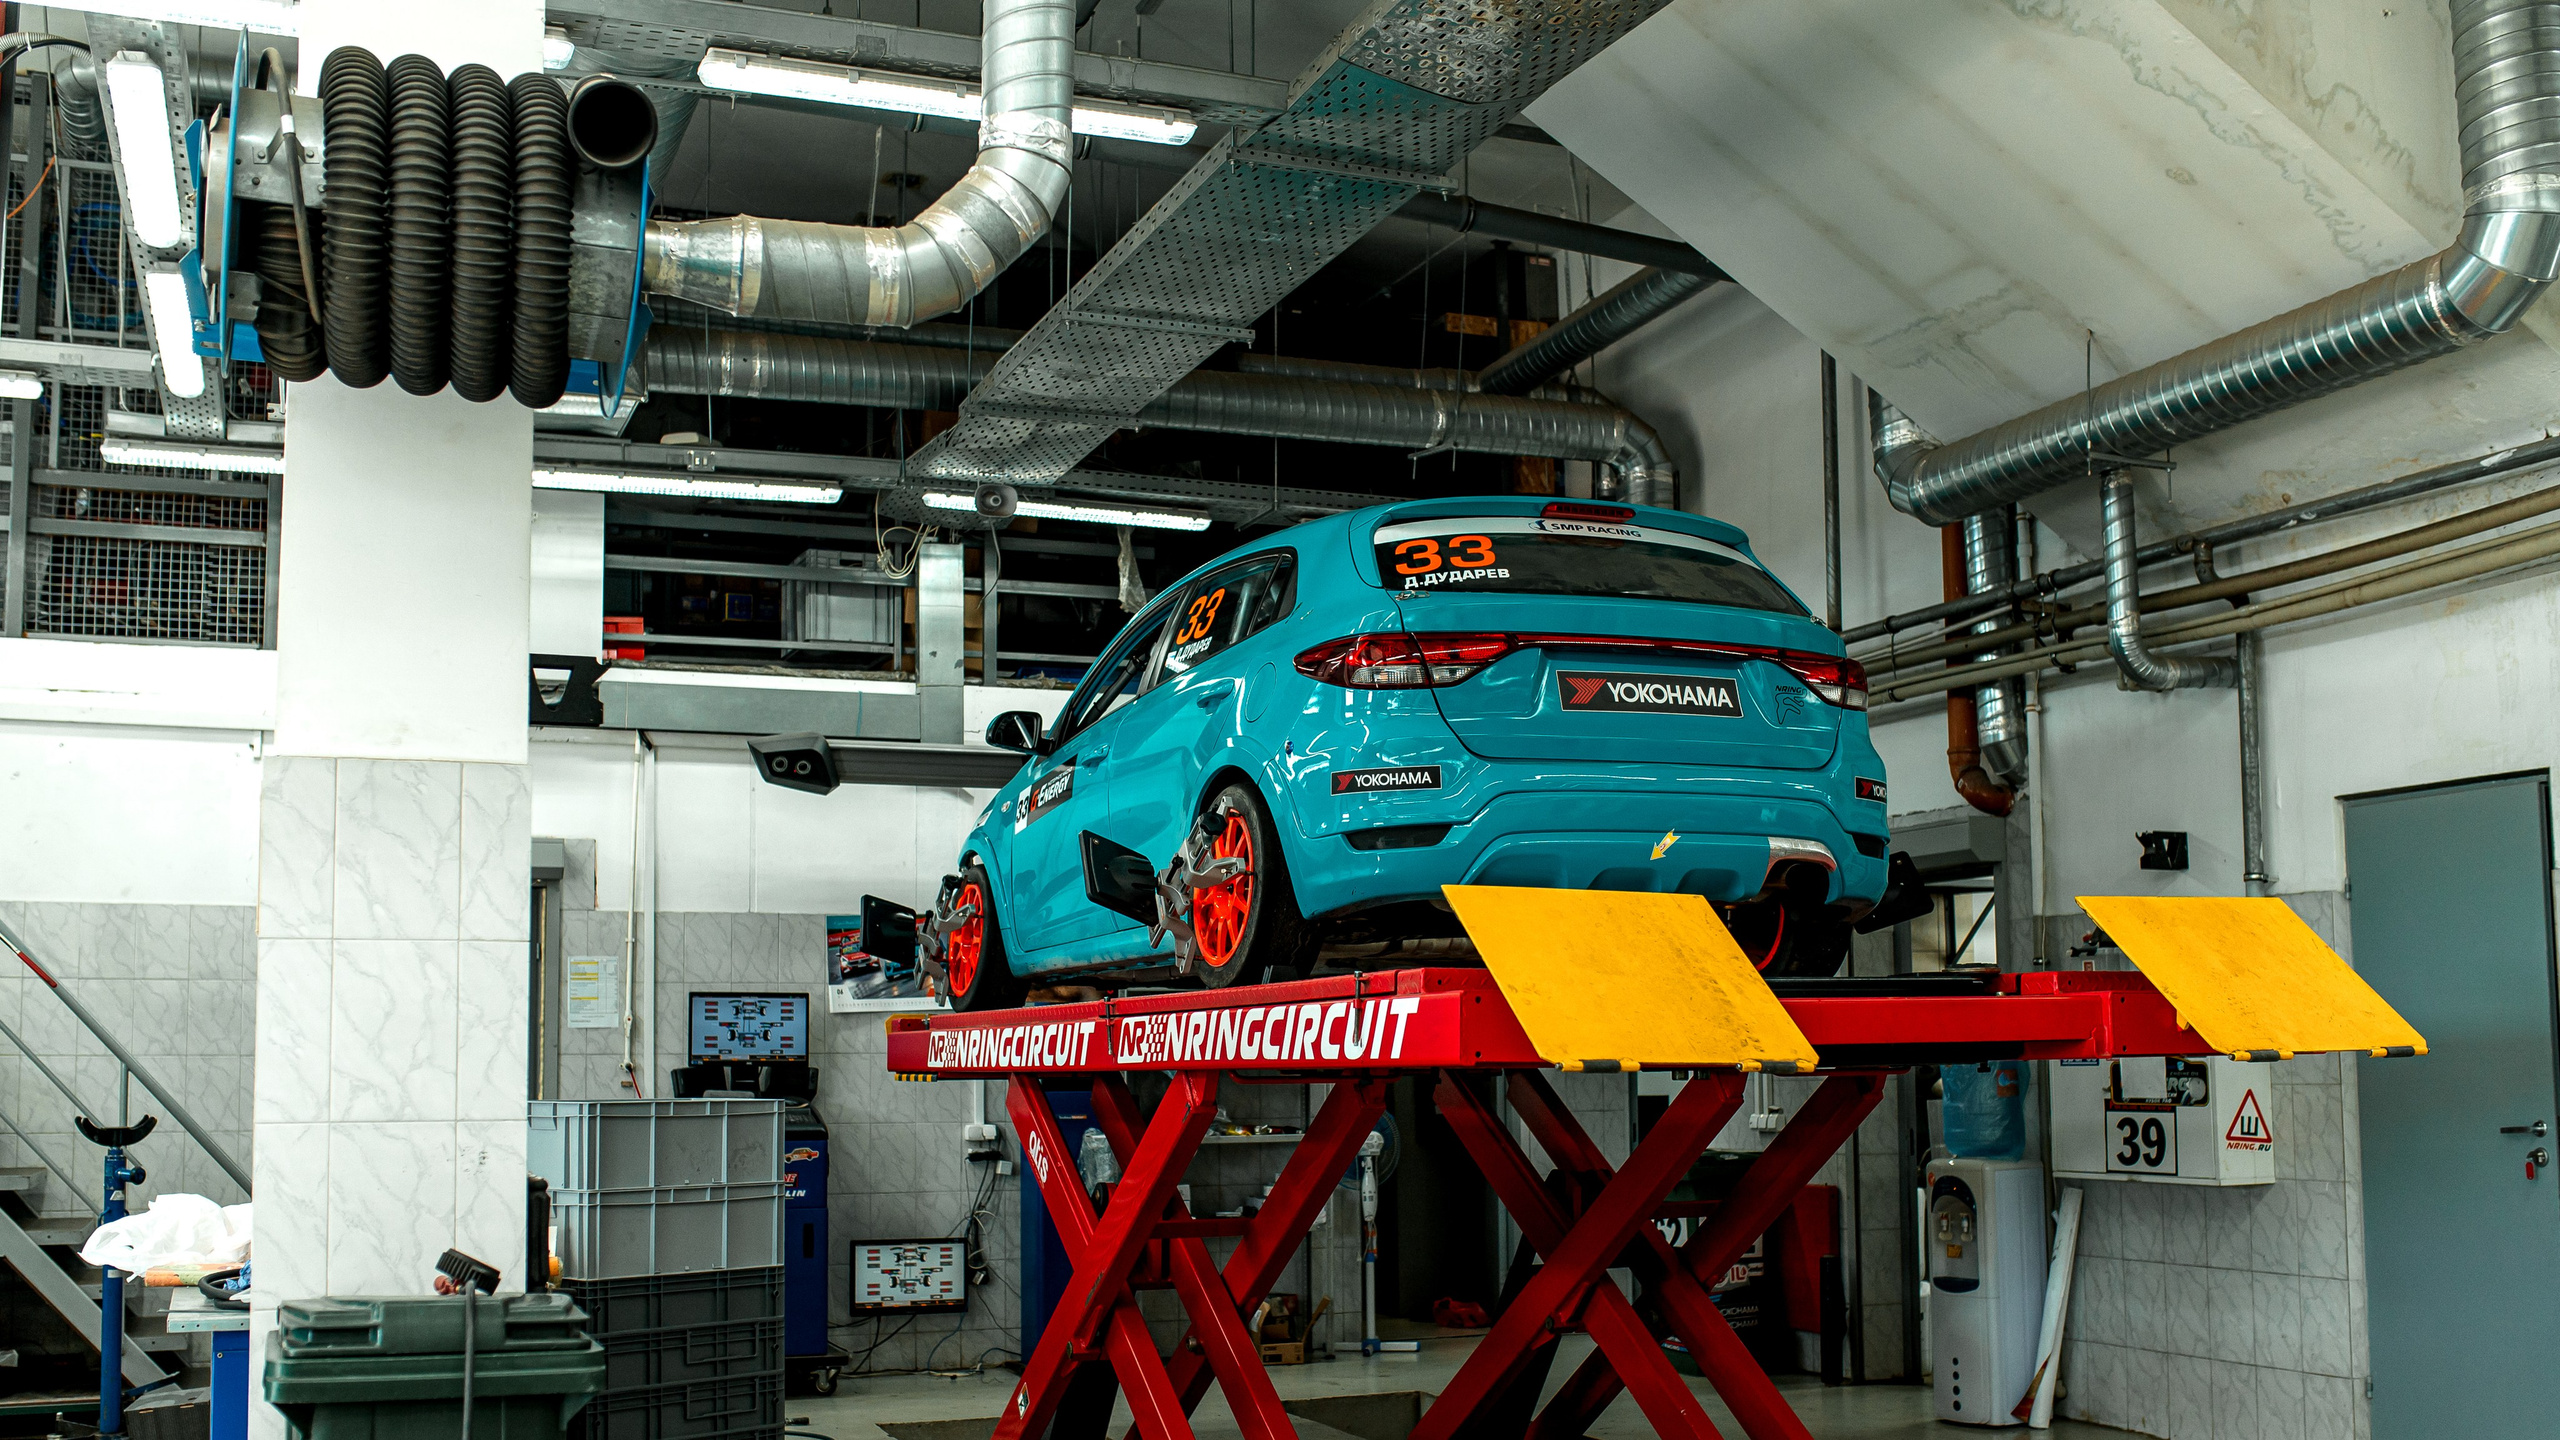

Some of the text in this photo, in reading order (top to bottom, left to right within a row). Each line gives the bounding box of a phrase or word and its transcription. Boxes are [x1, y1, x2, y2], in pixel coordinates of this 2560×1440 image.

[1551, 522, 1642, 538] SMP RACING
[1395, 535, 1496, 575] 33
[1404, 568, 1511, 590] Д.ДУДАРЕВ
[1176, 588, 1226, 645] 33
[1606, 681, 1734, 708] YOKOHAMA
[1775, 685, 1802, 693] NRING
[1354, 771, 1433, 788] YOKOHAMA
[1016, 796, 1030, 824] 33
[1163, 997, 1420, 1061] NRINGCIRCUIT
[955, 1021, 1096, 1068] NRINGCIRCUIT
[2116, 1116, 2167, 1167] 39
[2226, 1142, 2272, 1152] NRING.RU
